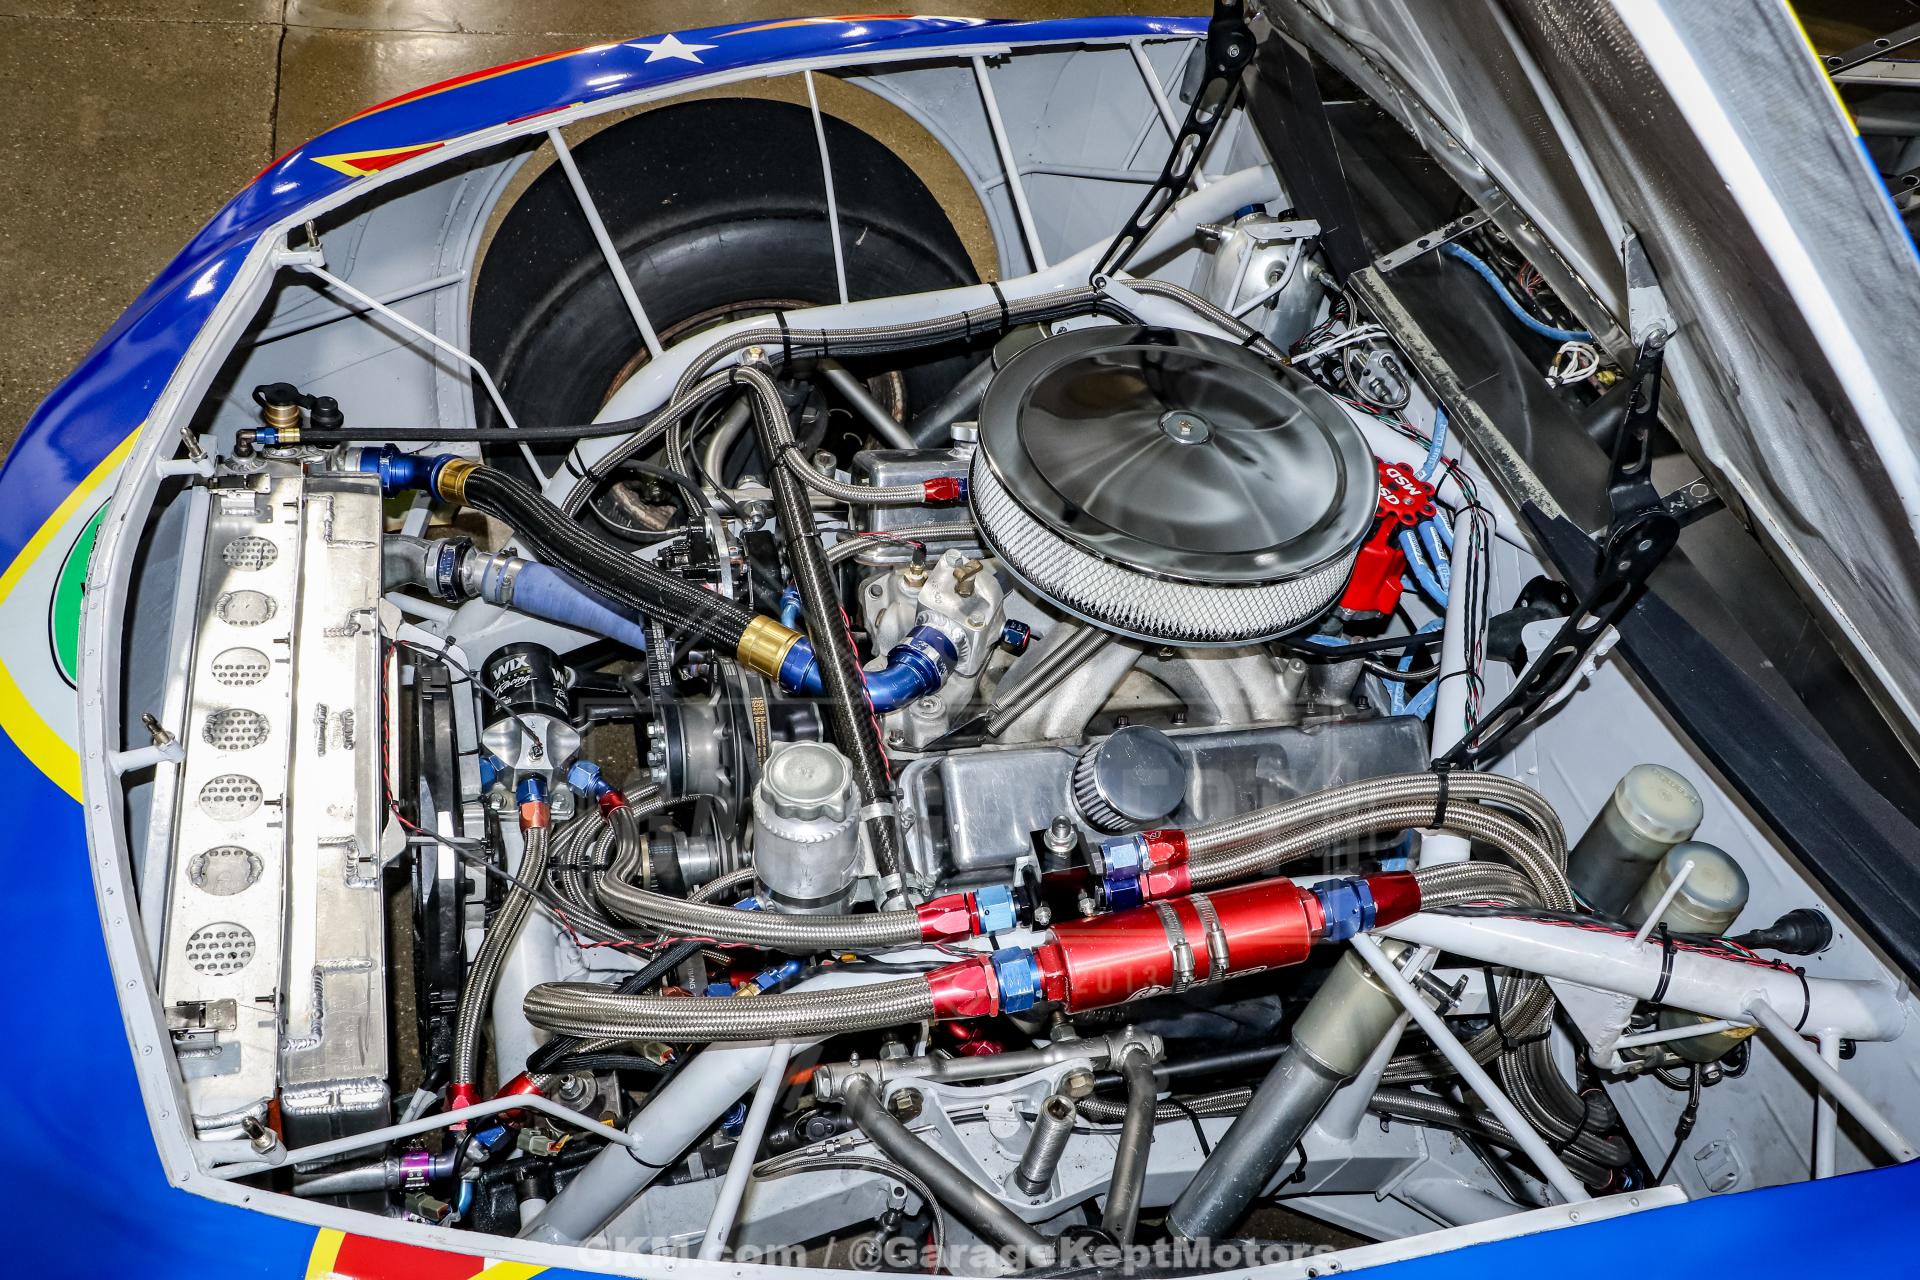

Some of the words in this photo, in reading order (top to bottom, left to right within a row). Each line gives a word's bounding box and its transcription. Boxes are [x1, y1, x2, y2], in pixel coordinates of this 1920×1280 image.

[1379, 483, 1400, 505] SD
[1386, 468, 1422, 496] MSD
[492, 655, 530, 680] WIX
[494, 674, 538, 697] Racing
